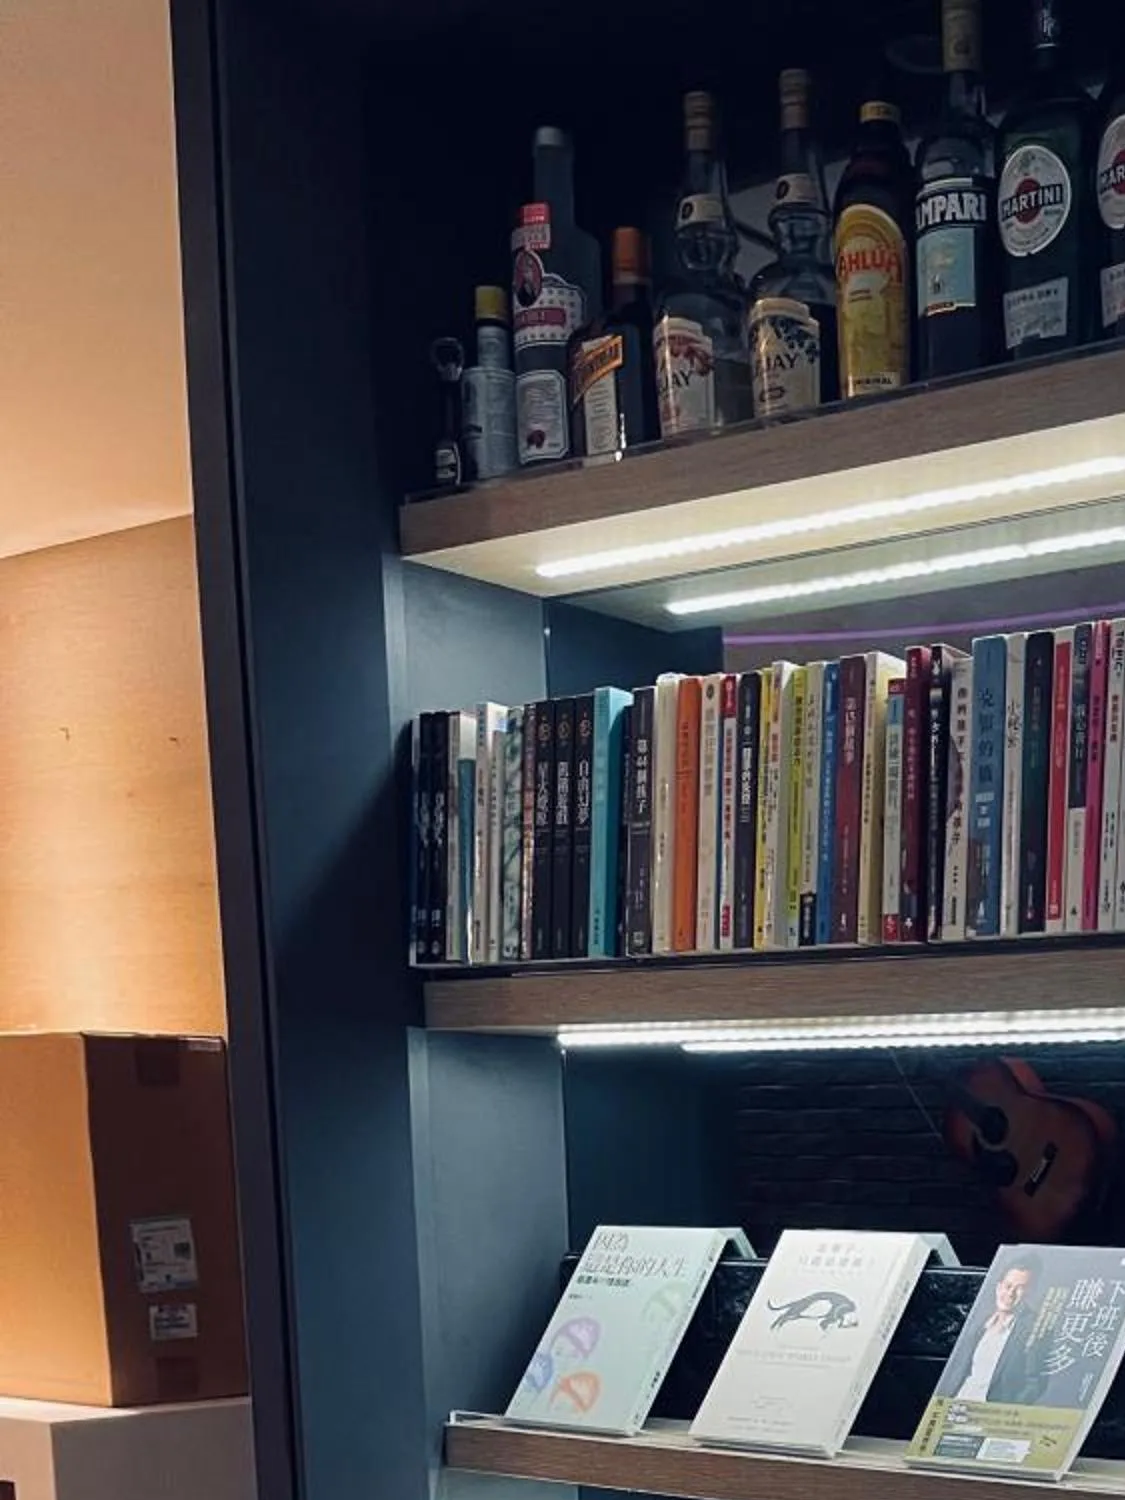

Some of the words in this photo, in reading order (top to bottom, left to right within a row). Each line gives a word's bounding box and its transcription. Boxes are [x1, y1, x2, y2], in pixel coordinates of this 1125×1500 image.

[1002, 184, 1064, 220] MARTINI
[1040, 1276, 1106, 1377] 賺更多
